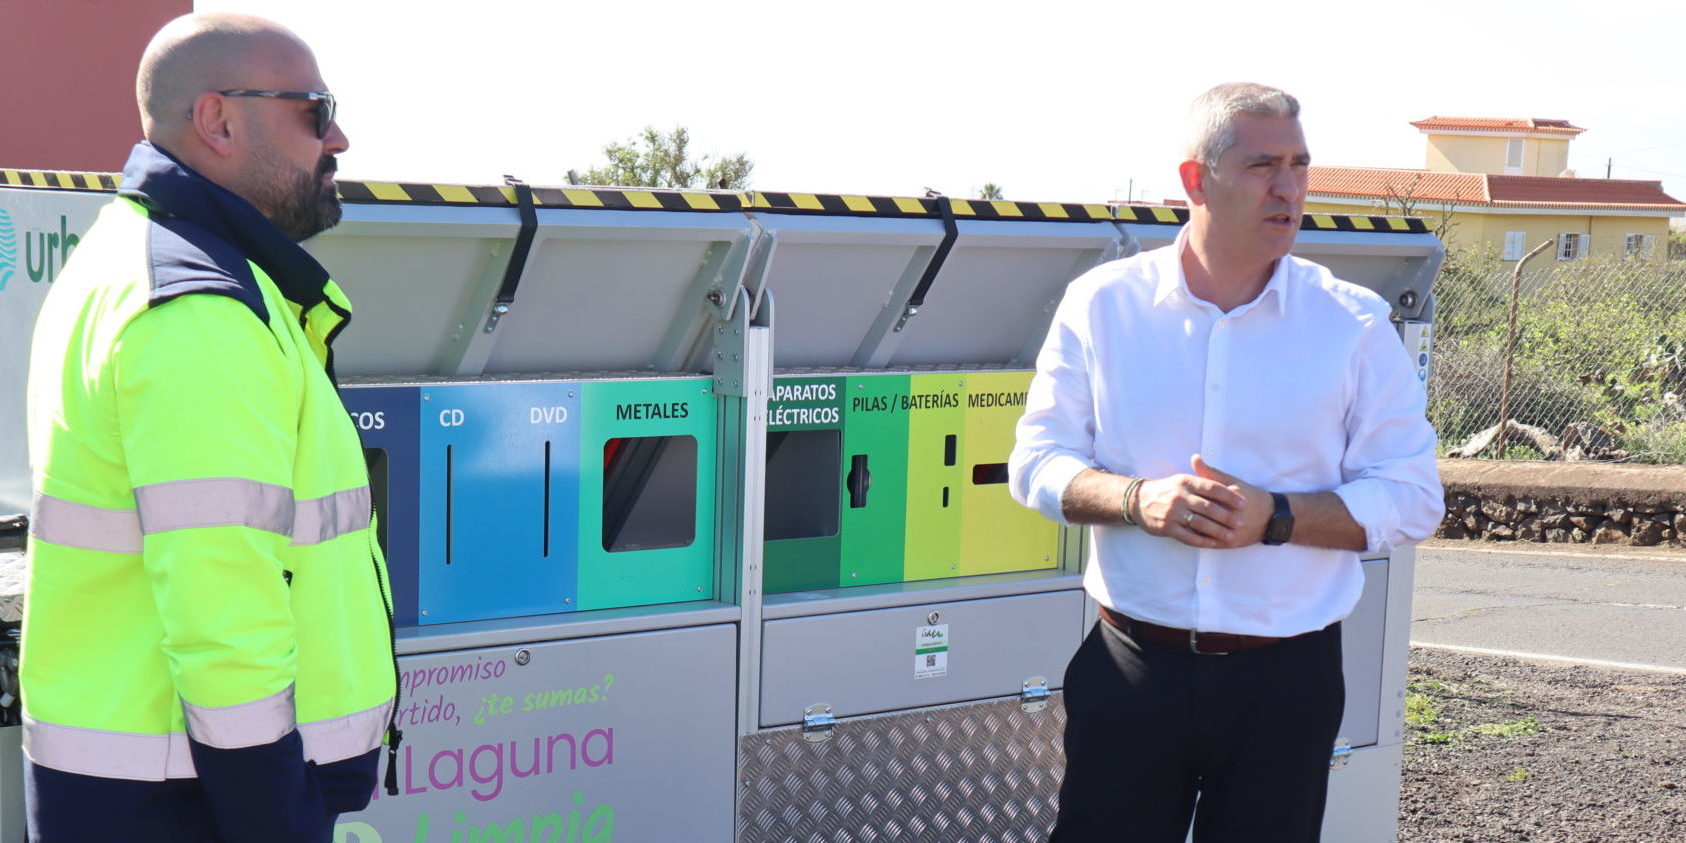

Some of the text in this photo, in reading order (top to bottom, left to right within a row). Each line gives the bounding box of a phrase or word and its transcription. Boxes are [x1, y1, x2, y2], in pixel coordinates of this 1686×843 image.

[853, 396, 888, 412] PILAS
[901, 390, 959, 410] BATERÍAS
[968, 392, 1028, 408] MEDICAM
[439, 409, 465, 427] CD
[530, 406, 568, 425] DVD
[616, 402, 689, 420] METALES
[767, 405, 839, 425] LÉCTRICOS
[520, 674, 615, 712] sumas?
[405, 727, 614, 801] Laguna
